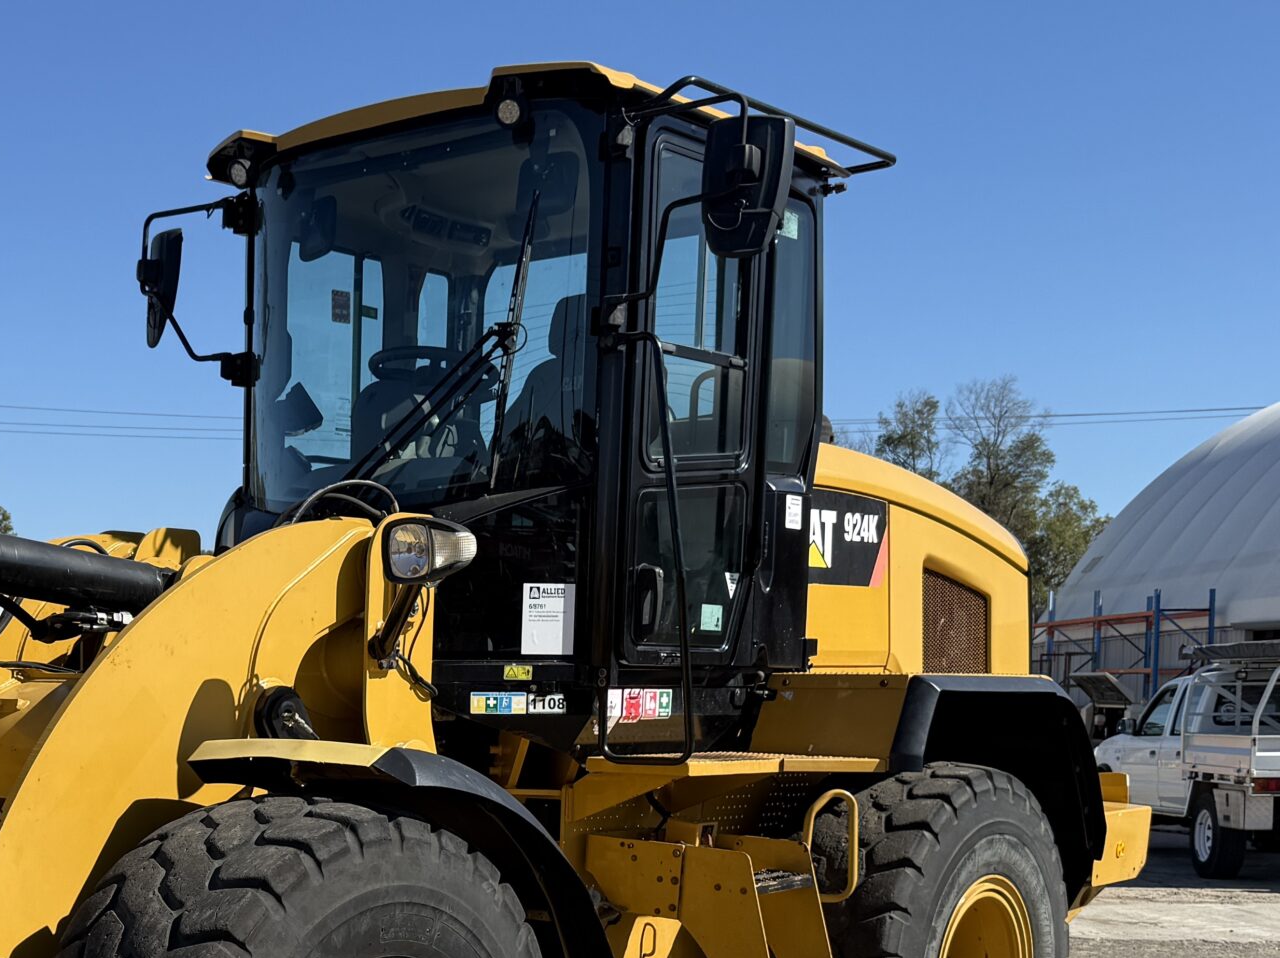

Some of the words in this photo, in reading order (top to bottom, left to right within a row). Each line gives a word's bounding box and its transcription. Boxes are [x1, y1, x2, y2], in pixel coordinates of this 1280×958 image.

[809, 508, 837, 568] AT
[843, 512, 880, 544] 924K
[542, 587, 566, 595] ALLIED
[531, 697, 564, 710] 1108
